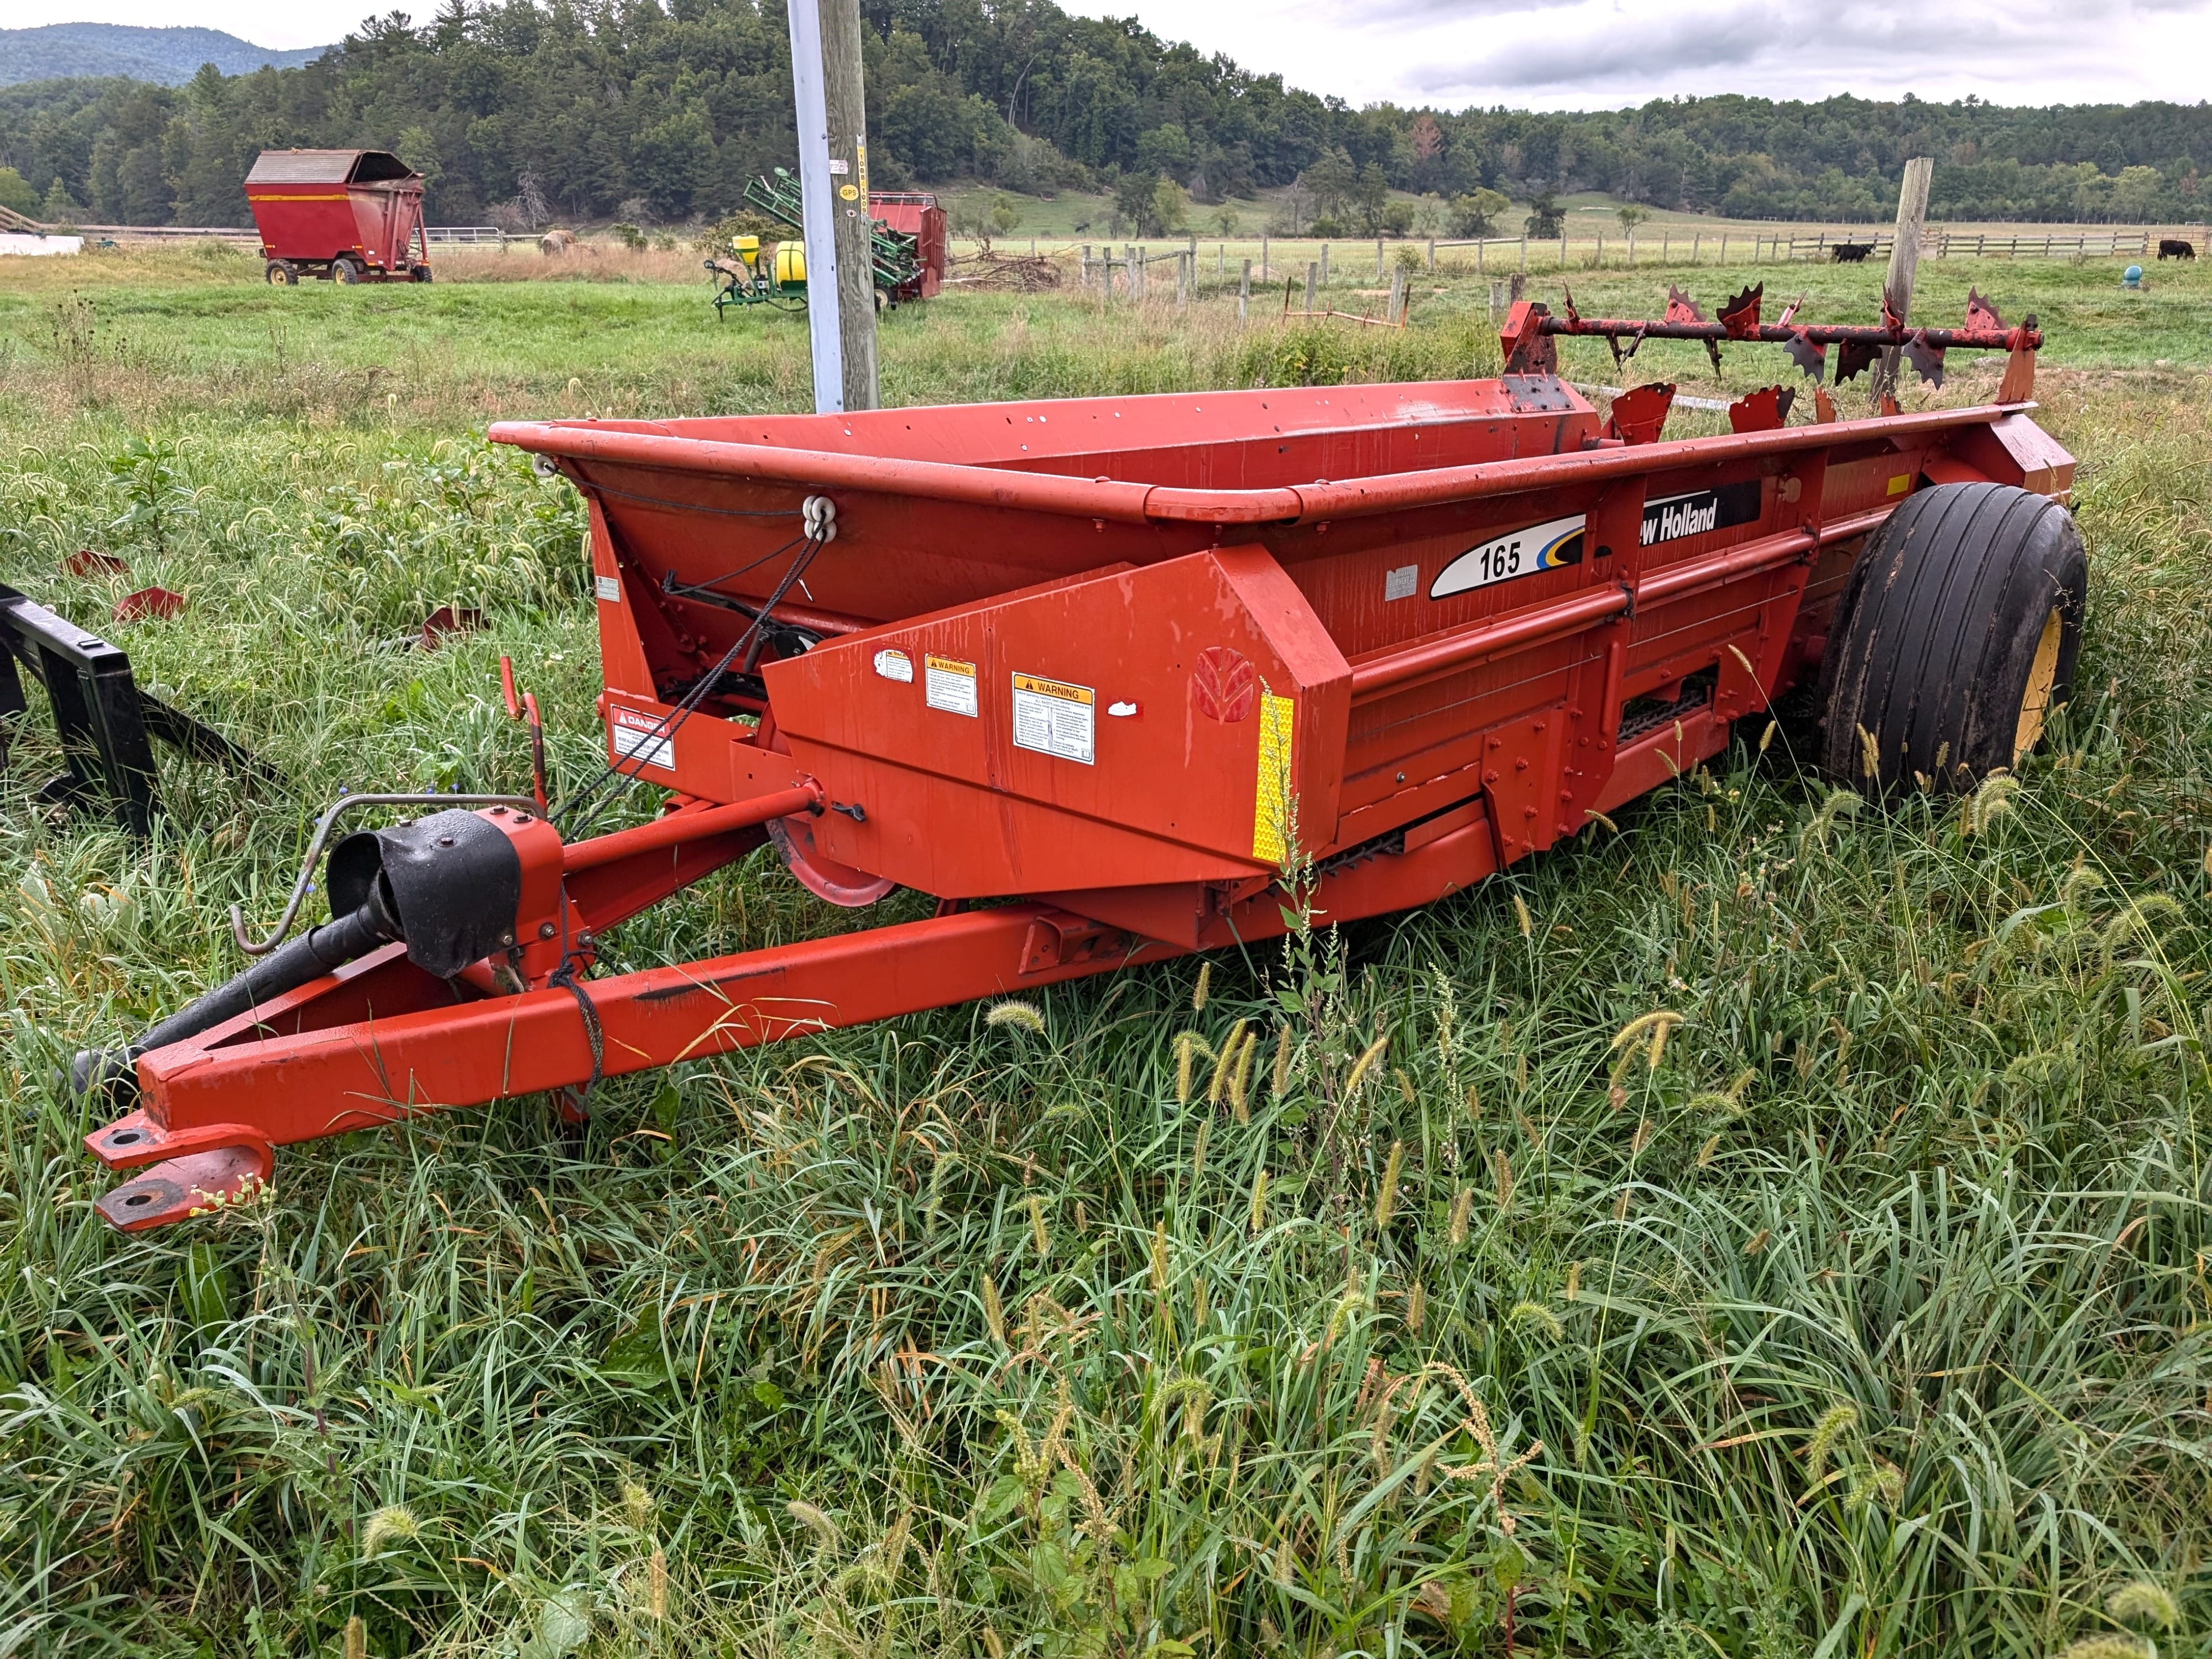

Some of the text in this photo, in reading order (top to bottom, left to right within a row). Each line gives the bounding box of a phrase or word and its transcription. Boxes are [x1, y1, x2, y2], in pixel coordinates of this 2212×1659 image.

[1660, 498, 1718, 541] Holland
[1480, 541, 1521, 581] 165
[938, 661, 970, 674] WARNING
[1037, 682, 1079, 700] WARNING
